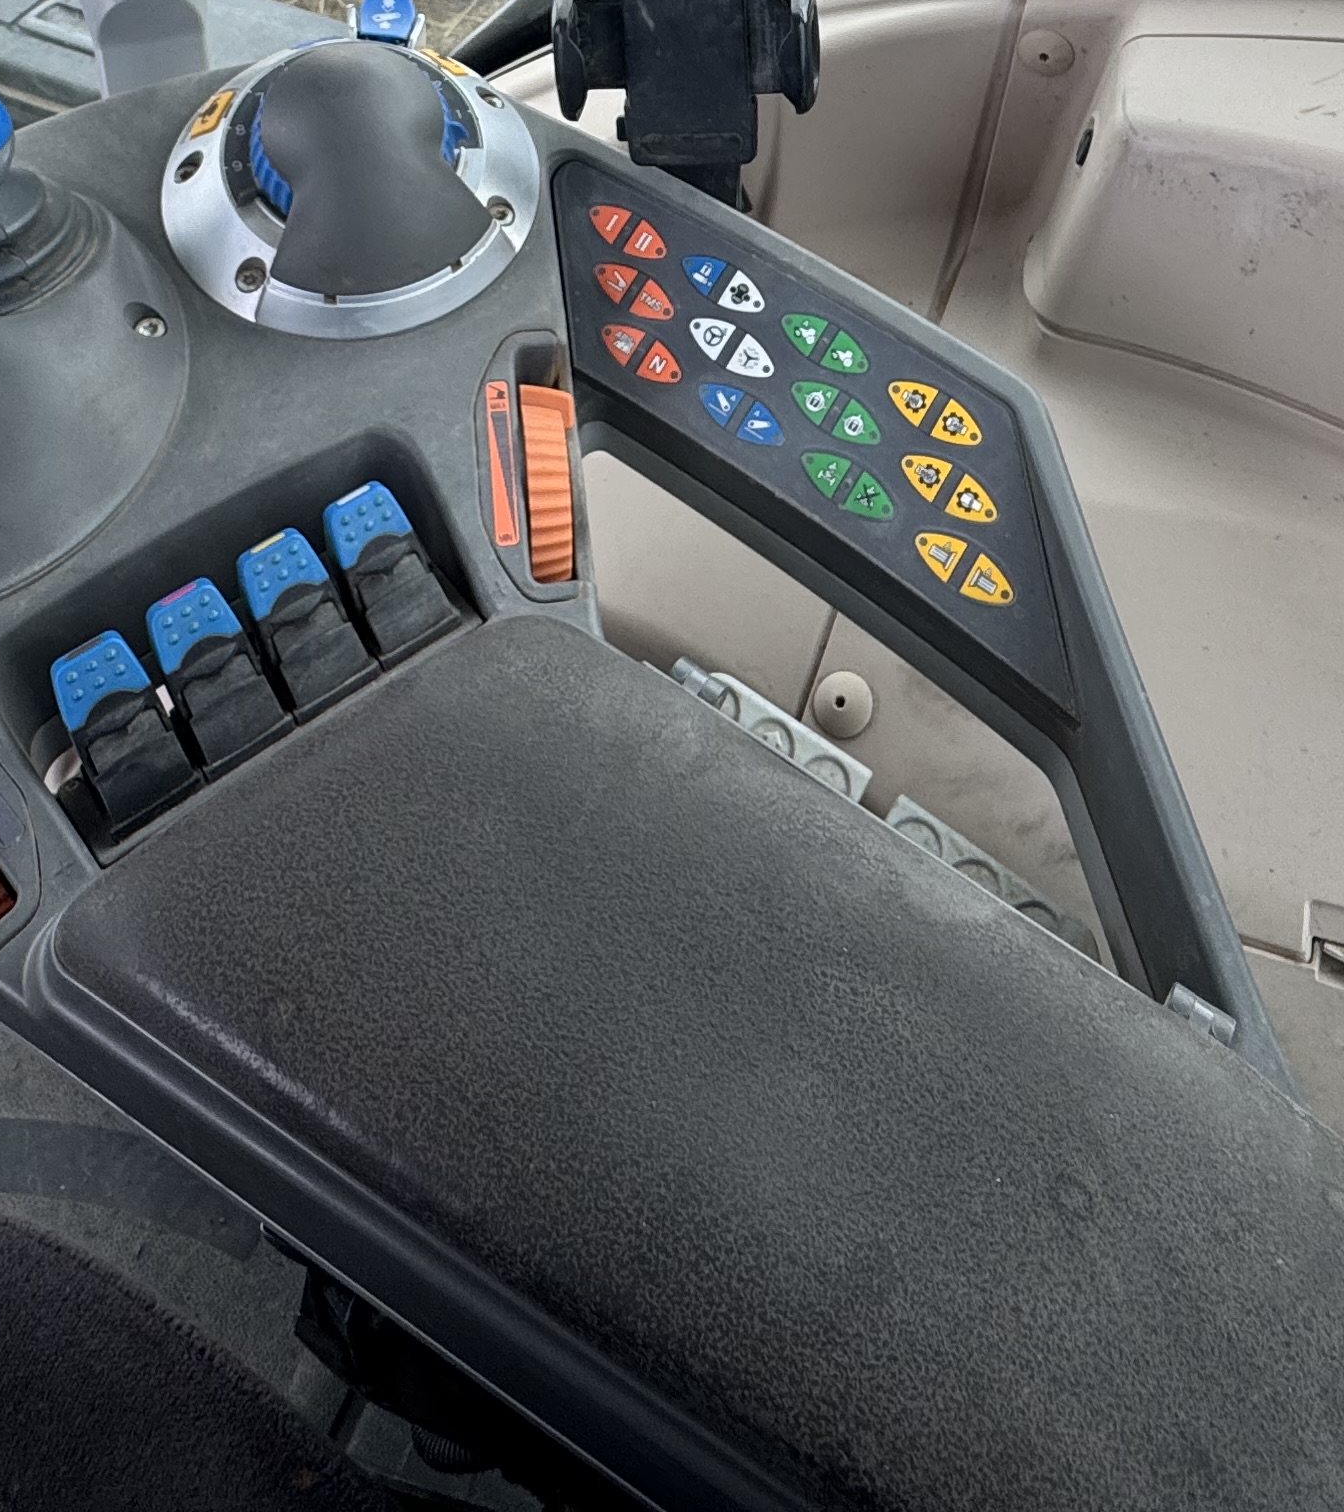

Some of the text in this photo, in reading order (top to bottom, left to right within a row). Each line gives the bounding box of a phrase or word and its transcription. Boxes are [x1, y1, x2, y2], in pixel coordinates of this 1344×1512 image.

[235, 124, 246, 136] 8
[232, 160, 243, 171] 9
[639, 291, 662, 312] TMS
[649, 354, 667, 374] N
[490, 402, 506, 410] MAX
[498, 533, 513, 543] MIN
